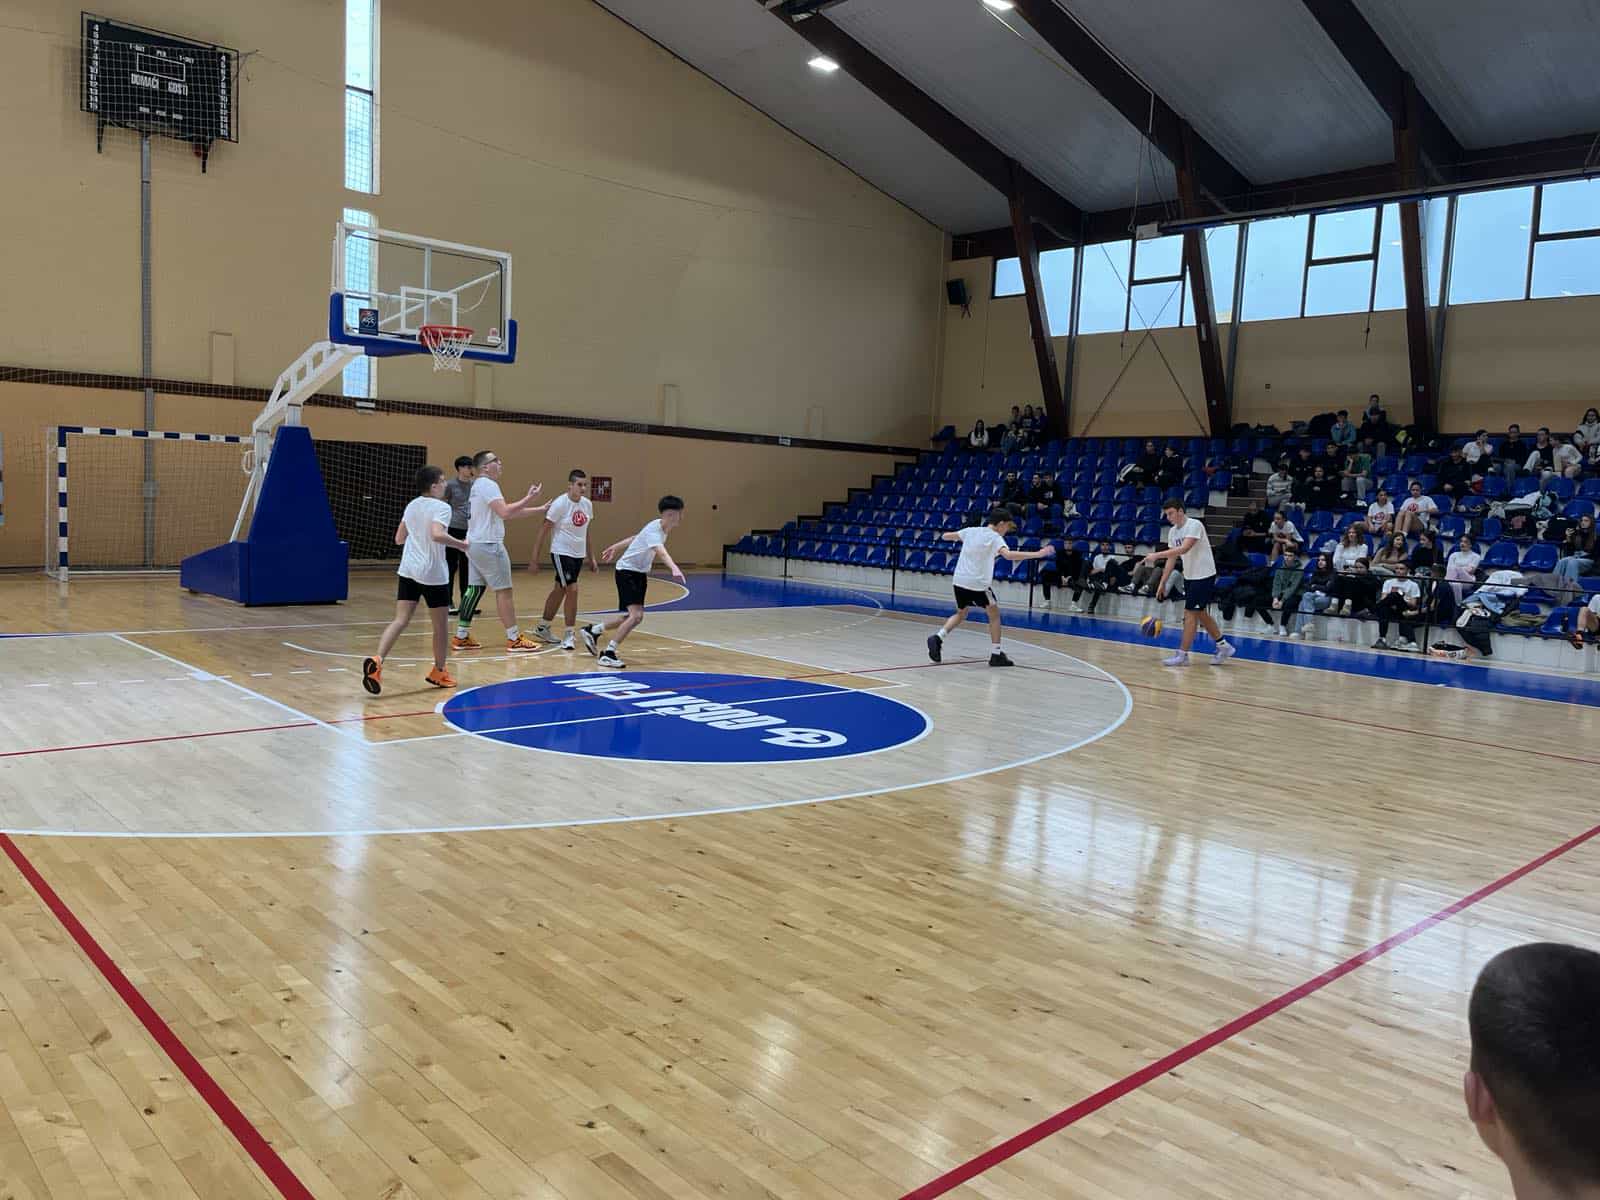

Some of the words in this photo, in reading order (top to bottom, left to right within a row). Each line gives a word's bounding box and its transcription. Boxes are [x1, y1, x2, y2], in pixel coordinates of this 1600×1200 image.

[167, 80, 189, 96] GOSTI
[551, 676, 678, 700] FOM
[631, 695, 787, 731] GOŠA
